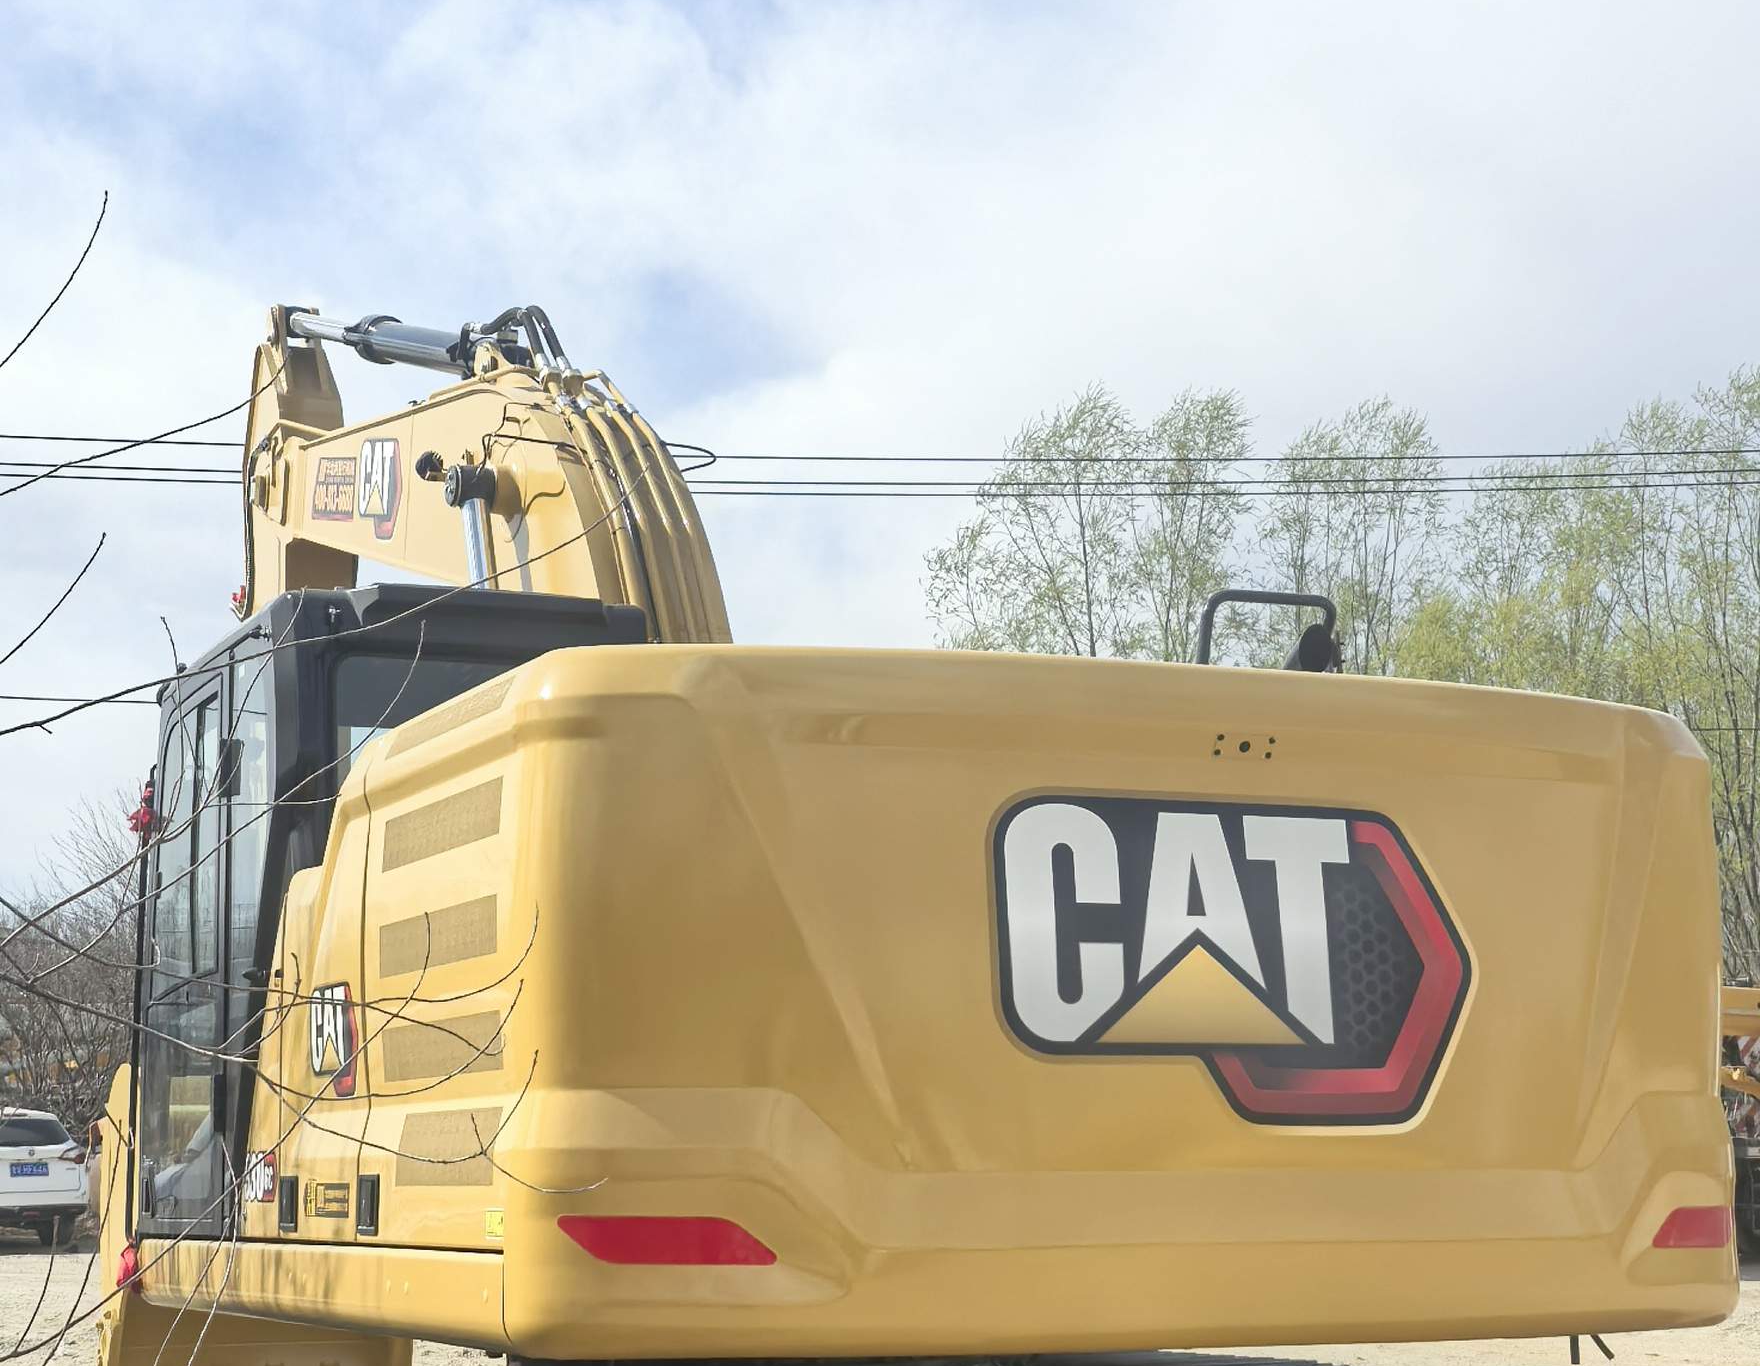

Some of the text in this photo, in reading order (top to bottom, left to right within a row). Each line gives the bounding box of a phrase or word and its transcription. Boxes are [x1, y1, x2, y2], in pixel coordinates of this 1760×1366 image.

[361, 441, 395, 515] CAT
[1004, 803, 1349, 1044] CAT
[311, 985, 345, 1072] CAT
